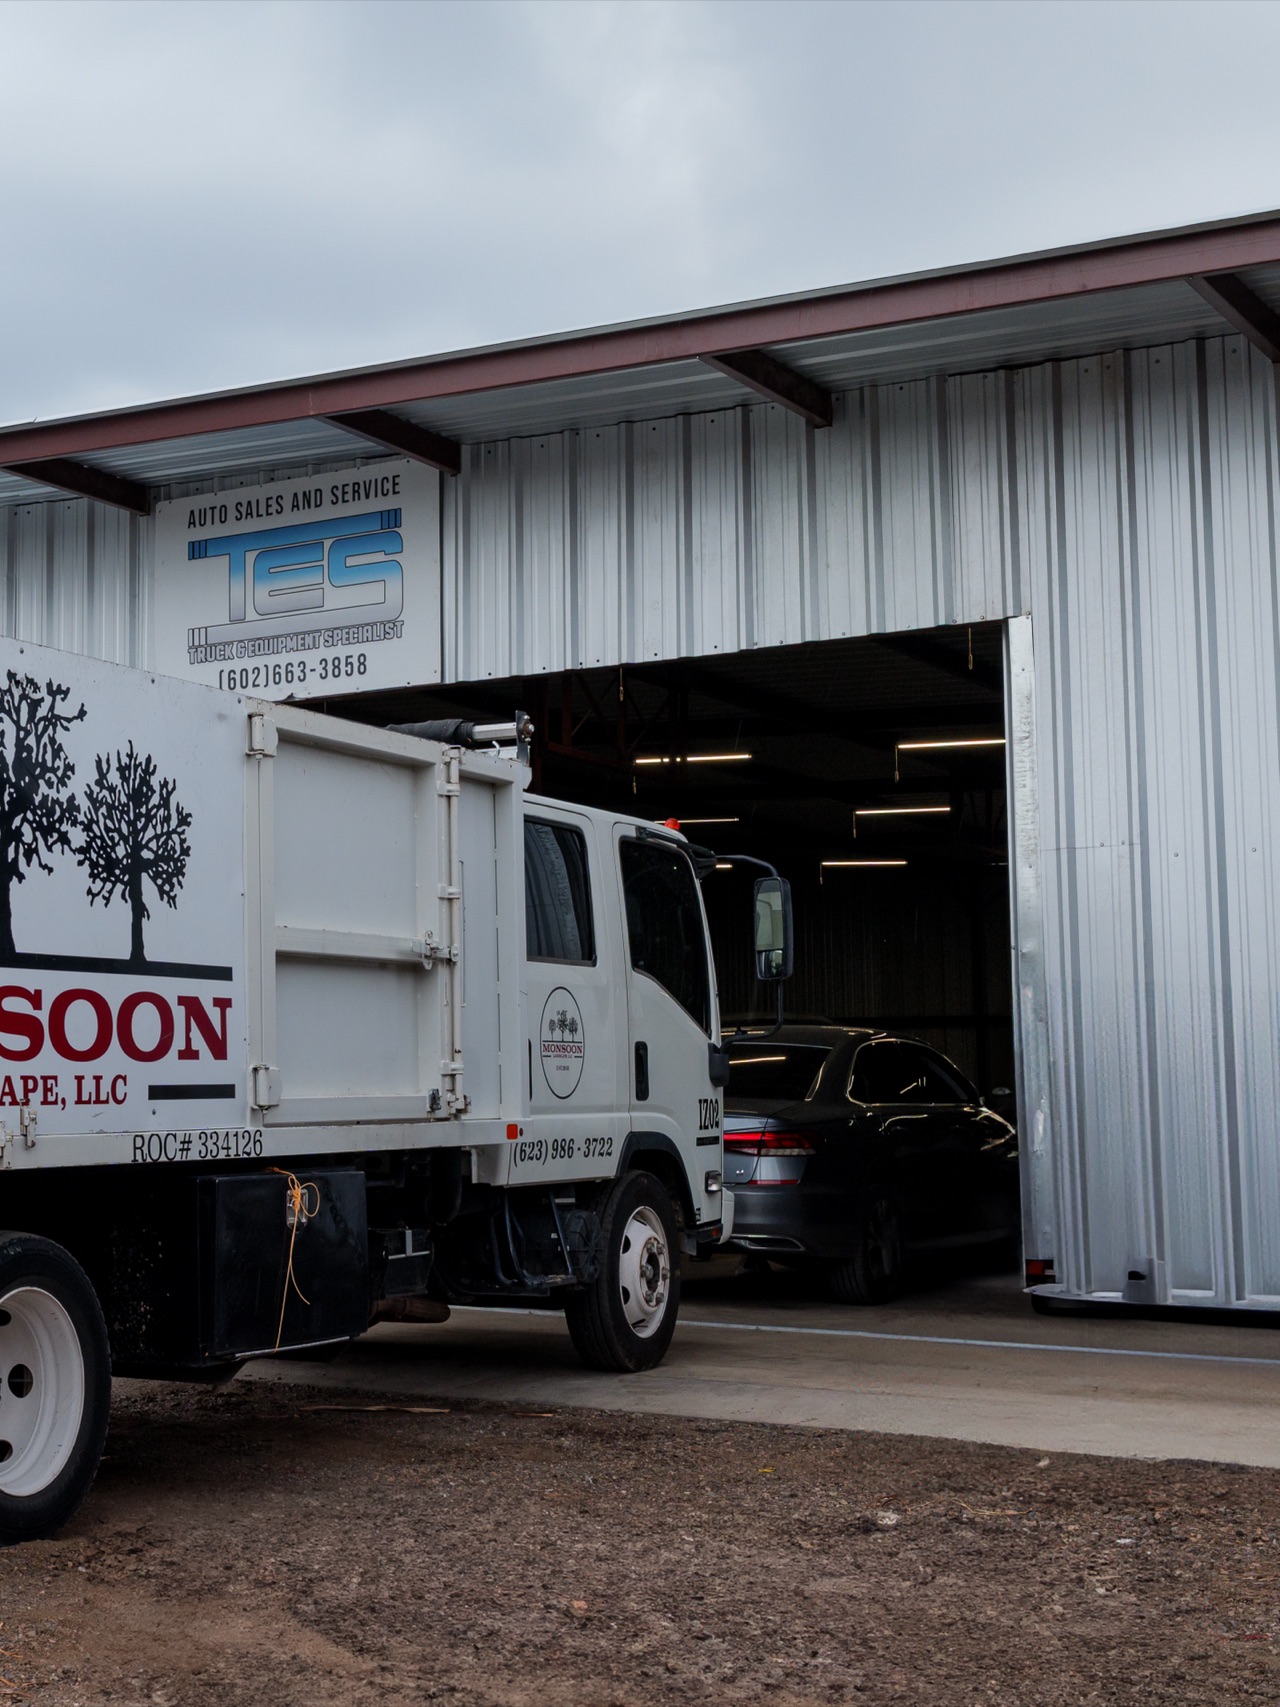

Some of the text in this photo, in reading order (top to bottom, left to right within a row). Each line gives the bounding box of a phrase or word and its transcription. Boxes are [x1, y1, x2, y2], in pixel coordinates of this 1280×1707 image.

[188, 474, 401, 529] AUTO SALES AND SERVICE
[188, 508, 403, 646] TES
[188, 641, 234, 665] TRUCK
[247, 631, 322, 658] EQUIPMENT
[323, 620, 404, 648] SPECIALIST
[219, 653, 368, 691] (602)663-3858
[542, 1043, 583, 1054] MONSOON
[74, 1073, 128, 1106] LLC
[131, 1129, 263, 1164] ROC# 334126
[513, 1139, 549, 1167] (623)
